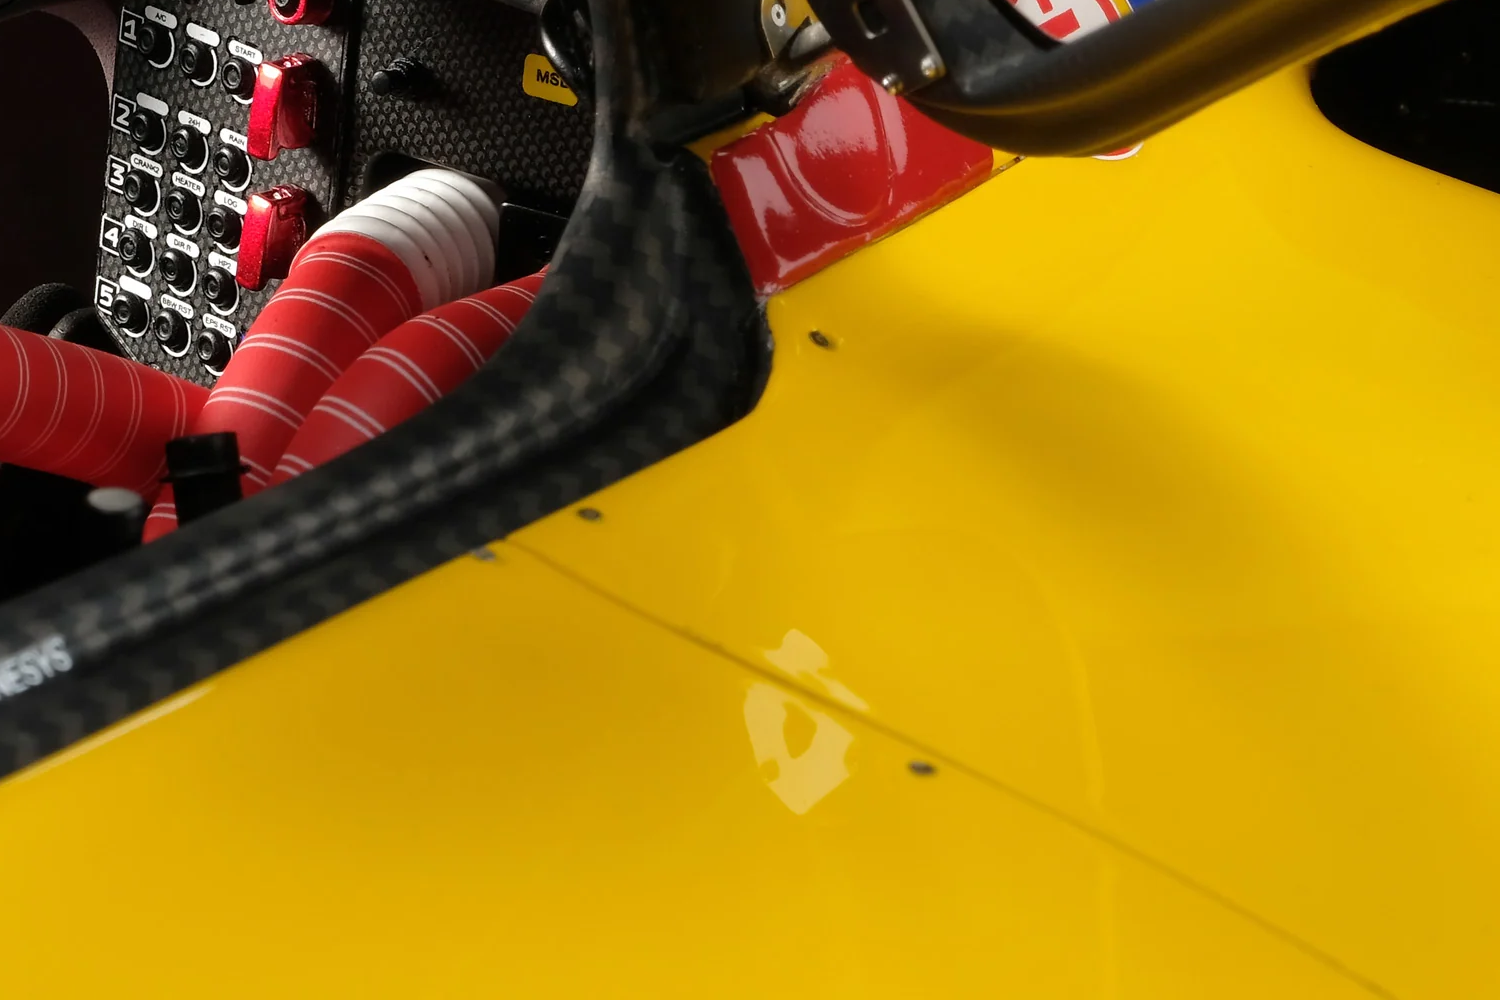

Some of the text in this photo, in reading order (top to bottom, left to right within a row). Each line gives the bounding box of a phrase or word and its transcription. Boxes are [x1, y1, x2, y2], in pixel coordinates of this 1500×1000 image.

[154, 12, 167, 23] A/C
[123, 19, 137, 42] 1
[235, 45, 257, 59] START
[116, 102, 131, 127] 2
[188, 116, 201, 128] 24H
[228, 134, 246, 147] RAIN
[110, 162, 125, 186] 3
[133, 156, 160, 174] CRANK2
[174, 174, 202, 193] HEATER
[223, 196, 238, 209] LOG
[132, 220, 145, 231] DIR
[104, 226, 119, 248] 4
[173, 237, 185, 249] DIR
[218, 258, 232, 271] HP2
[99, 283, 114, 307] 5
[162, 297, 192, 316] BBW RST
[205, 316, 234, 335] EPS RST
